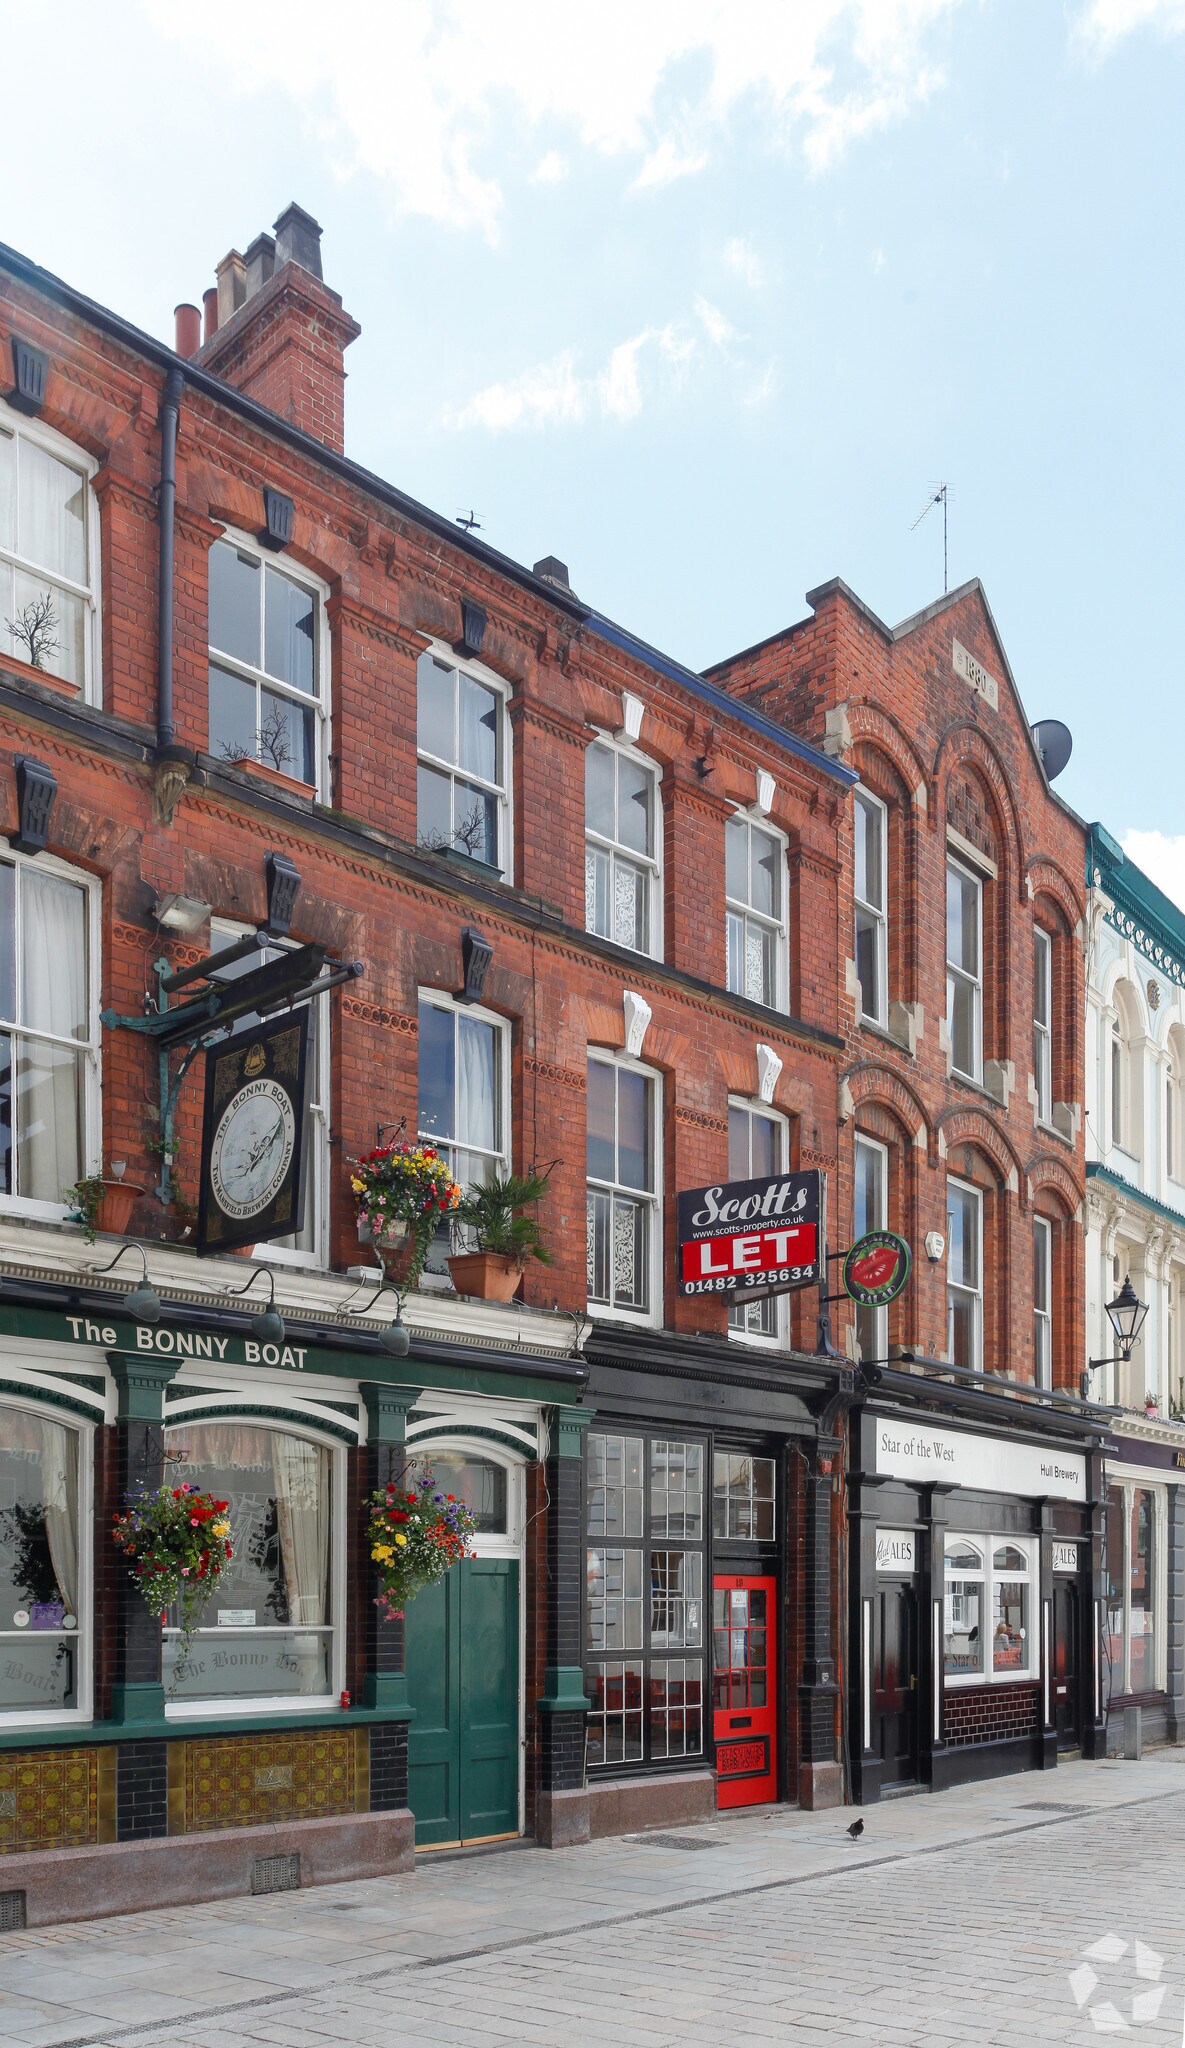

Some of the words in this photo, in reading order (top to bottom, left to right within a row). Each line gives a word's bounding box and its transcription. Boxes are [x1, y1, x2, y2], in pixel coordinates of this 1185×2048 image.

[965, 656, 987, 692] 1880
[216, 1115, 231, 1141] The
[232, 1082, 269, 1110] BONNY
[271, 1086, 291, 1115] BOAT
[215, 1185, 242, 1216] MANSFIELD
[242, 1189, 273, 1216] BREWERY
[272, 1141, 292, 1189] COMPANY
[692, 1182, 808, 1226] Scotts
[693, 1215, 804, 1239] www.scotts-property.co.uk
[701, 1229, 799, 1275] LET
[685, 1276, 737, 1294] 01482
[745, 1265, 814, 1286] 325634
[860, 1286, 896, 1304] SALAD
[65, 1316, 117, 1345] The
[136, 1326, 229, 1359] BONNY
[245, 1341, 308, 1368] BOAT
[881, 1433, 900, 1453] Star
[903, 1437, 915, 1455] of
[917, 1439, 931, 1458] the
[933, 1442, 955, 1462] West
[1040, 1463, 1053, 1477] Hull
[1054, 1466, 1078, 1484] Brewery
[891, 1542, 912, 1560] ALES
[1060, 1548, 1076, 1565] ALES
[172, 1660, 206, 1682] The
[211, 1650, 268, 1671] Bonny
